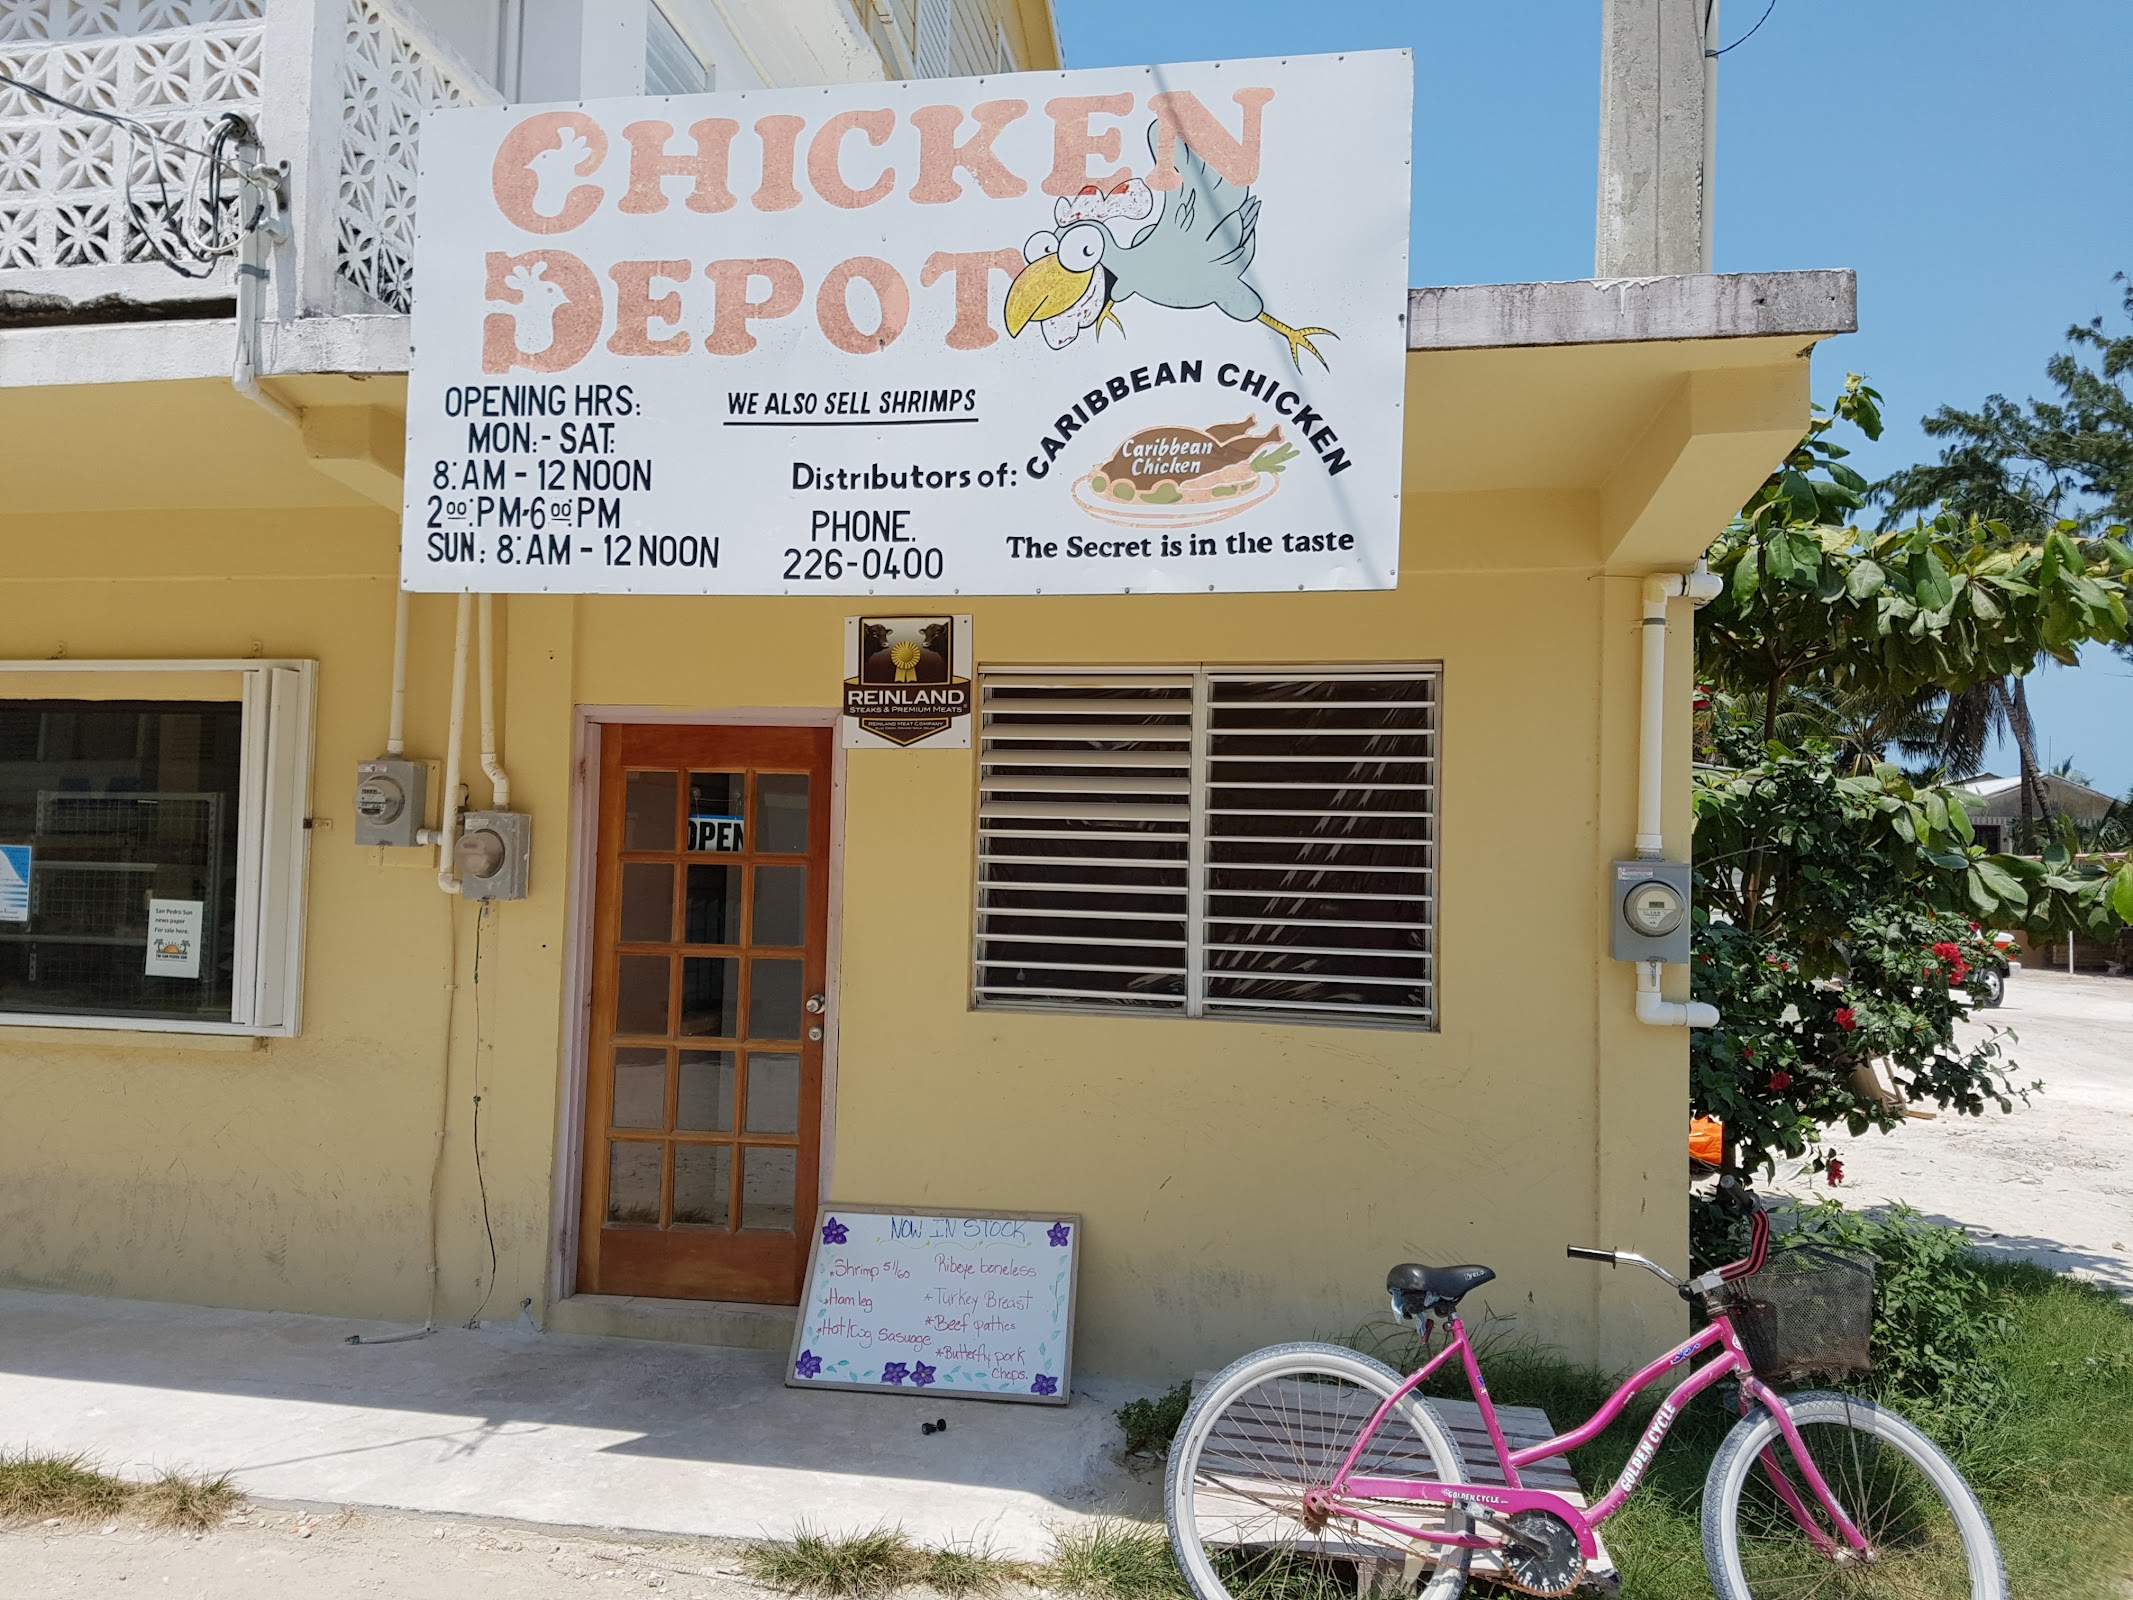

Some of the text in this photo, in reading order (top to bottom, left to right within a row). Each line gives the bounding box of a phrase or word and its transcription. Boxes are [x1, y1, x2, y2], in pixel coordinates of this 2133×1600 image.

[492, 86, 1275, 234] CHICKEN
[482, 249, 1028, 374] DEPOT
[445, 385, 641, 417] OPENING HRS:
[728, 389, 976, 415] WE ALSO SELL SHRIMPS
[1026, 360, 1352, 480] CARIBBEAN CHICKEN
[1122, 437, 1213, 458] Caribbean
[538, 459, 565, 491] 12
[573, 459, 651, 491] NOON
[792, 462, 1017, 490] Distributors of:
[1131, 458, 1201, 476] Chicken
[812, 510, 916, 542] PHONE.
[427, 532, 485, 563] SUN:
[604, 534, 632, 567] 12
[639, 535, 719, 568] NOON
[1007, 531, 1354, 559] The Secret is in the taste
[783, 547, 943, 580] 226-0400
[848, 689, 965, 705] REINLAND
[849, 706, 882, 714] STEAKS
[891, 1217, 1027, 1243] NOW IN STOCK
[835, 1259, 879, 1282] Shrimp
[934, 1253, 1037, 1279] Ribeye boneless
[829, 1288, 873, 1313] Ham leg
[933, 1287, 1033, 1314] Turkey Breast
[934, 1313, 1016, 1337] Beef patties
[943, 1344, 1025, 1368] Butterfly pork
[1621, 1440, 1654, 1492] GOLDEN
[1648, 1402, 1675, 1443] CYCLE
